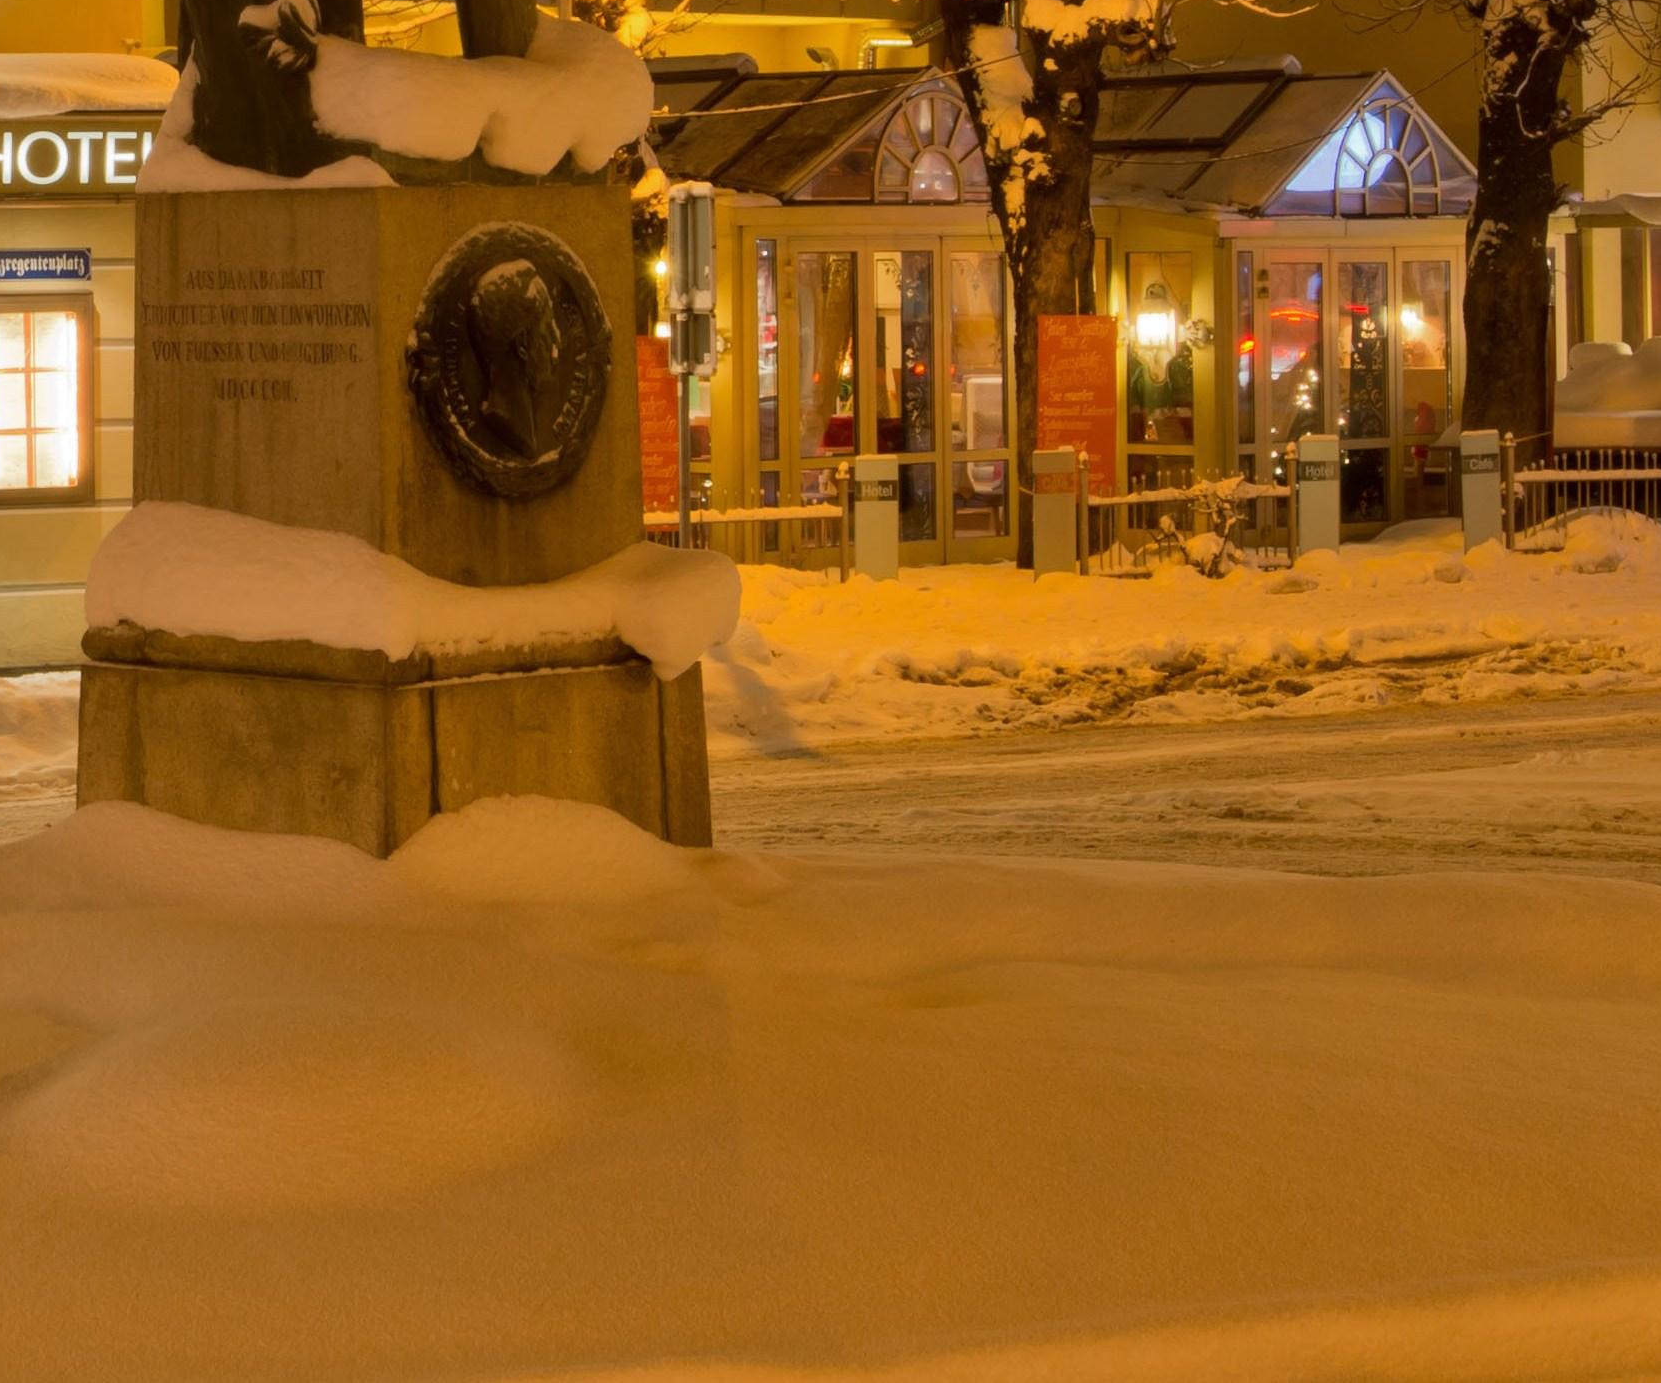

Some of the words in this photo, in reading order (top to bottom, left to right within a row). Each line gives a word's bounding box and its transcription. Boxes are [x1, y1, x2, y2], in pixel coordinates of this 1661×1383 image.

[152, 340, 182, 362] VON
[1305, 465, 1335, 481] Hotel
[861, 483, 893, 498] Hotel
